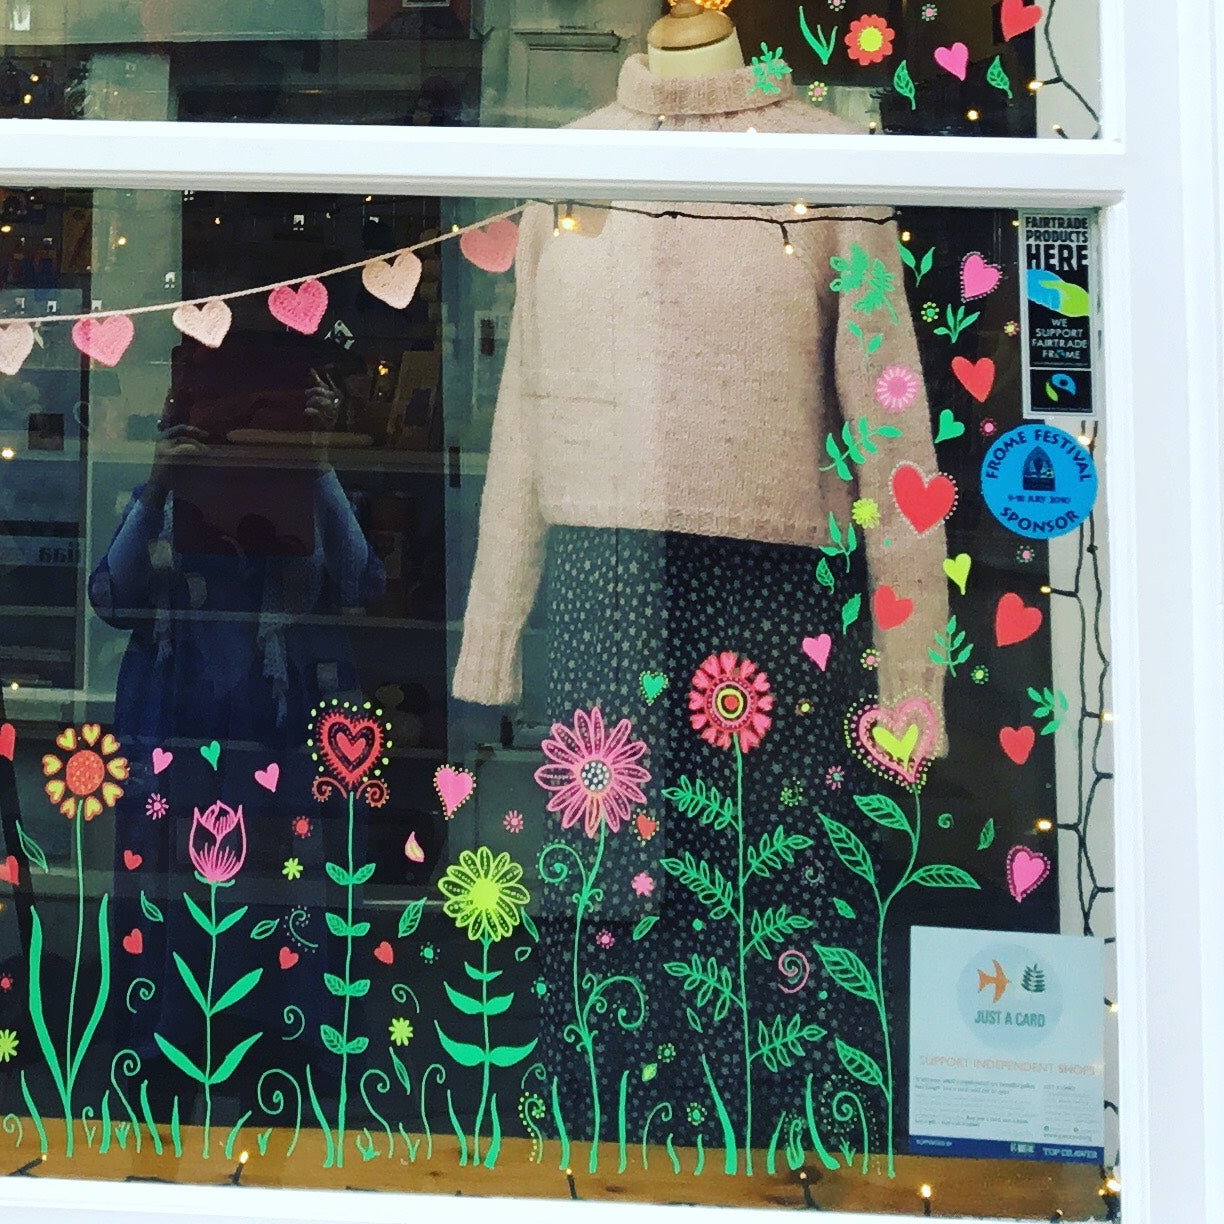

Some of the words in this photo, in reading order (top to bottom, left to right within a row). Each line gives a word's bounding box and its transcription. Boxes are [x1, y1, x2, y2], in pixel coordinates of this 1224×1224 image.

[1025, 216, 1088, 230] FAIRTRADE
[1026, 229, 1088, 244] PRODUCTS
[1026, 243, 1089, 271] HERE
[1051, 318, 1068, 328] WE
[1035, 328, 1083, 338] SUPPORT
[1031, 338, 1088, 349] FAIRTRADE
[986, 431, 1027, 480] FROME
[1034, 429, 1092, 483] FESTIVAL
[1000, 506, 1080, 533] SPONSOR
[974, 1010, 1003, 1025] JUST
[1005, 1012, 1013, 1025] A
[1015, 1012, 1046, 1028] CARD
